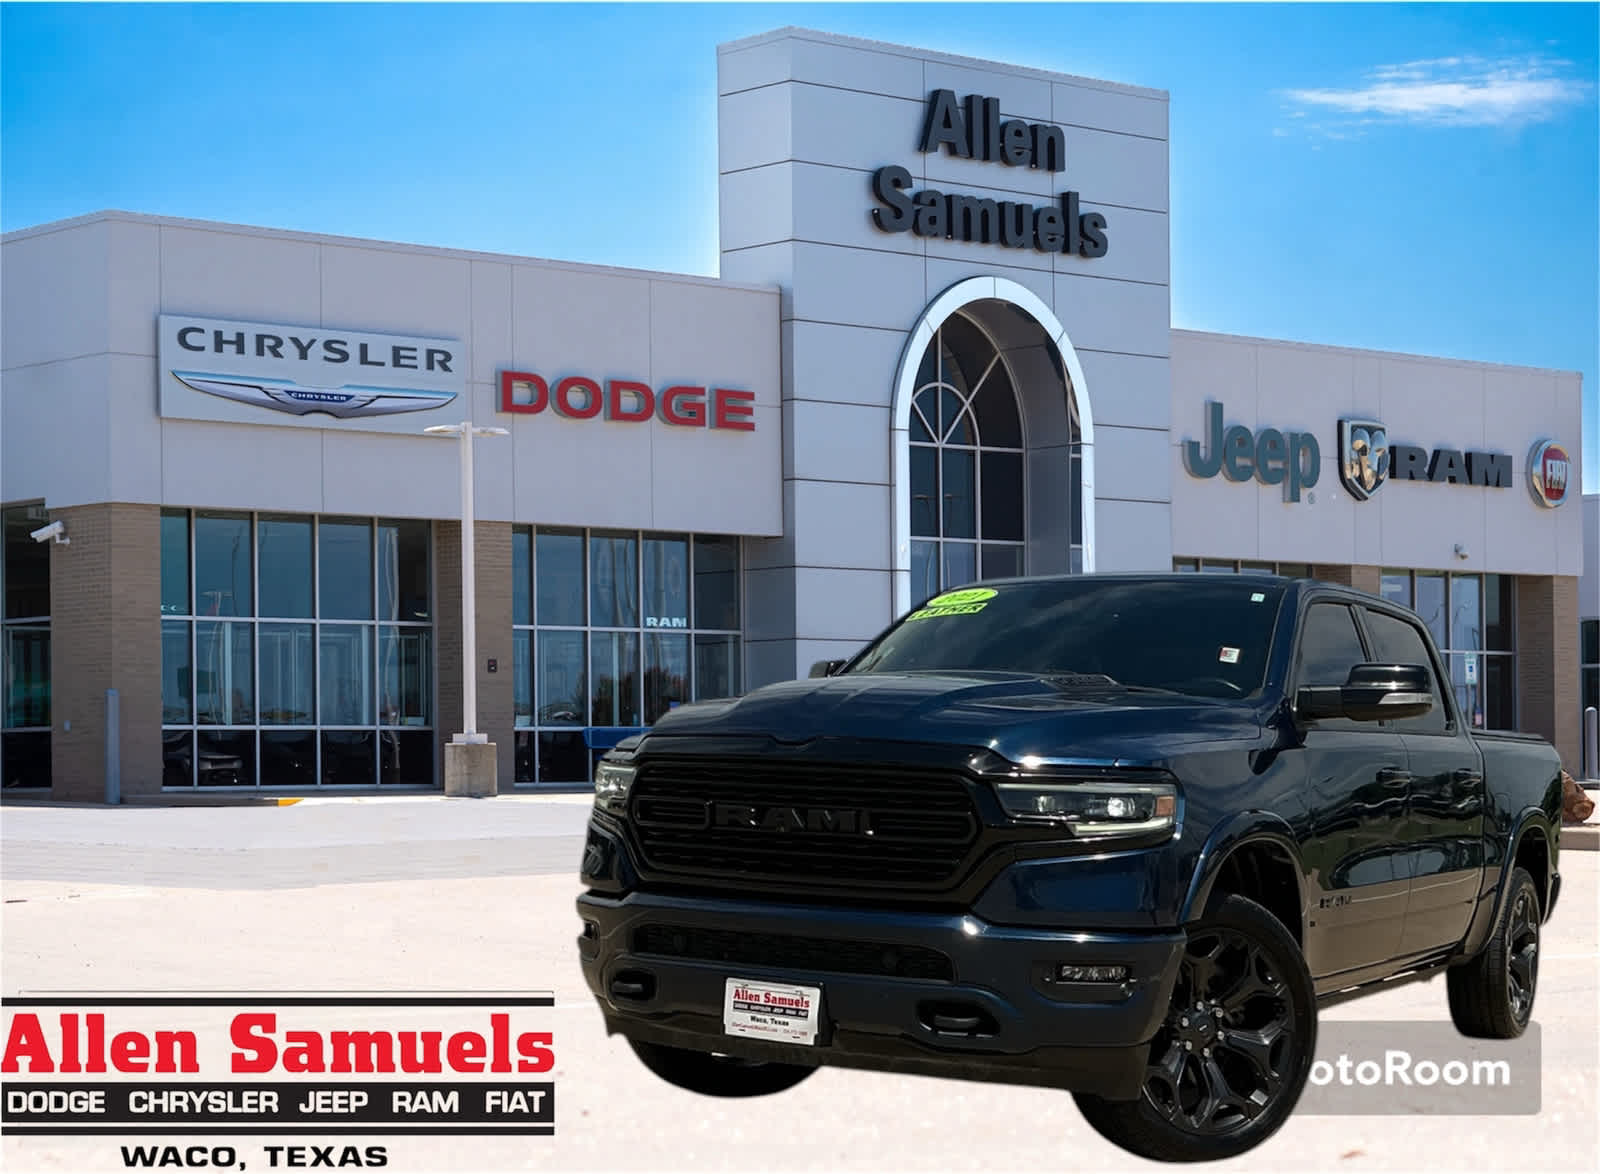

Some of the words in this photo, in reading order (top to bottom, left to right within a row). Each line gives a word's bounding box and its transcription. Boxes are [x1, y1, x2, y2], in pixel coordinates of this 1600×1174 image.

[919, 88, 1066, 172] Allen
[871, 165, 1108, 258] Samuels
[177, 326, 453, 372] CHRYSLER
[291, 391, 347, 401] CHRYSLER
[496, 370, 755, 432] DODGE
[1182, 399, 1320, 503] Jeep
[1389, 444, 1513, 488] RAM
[646, 616, 687, 627] RAM
[714, 803, 856, 833] RAM
[733, 989, 760, 1002] Allen
[764, 992, 810, 1008] Samuels
